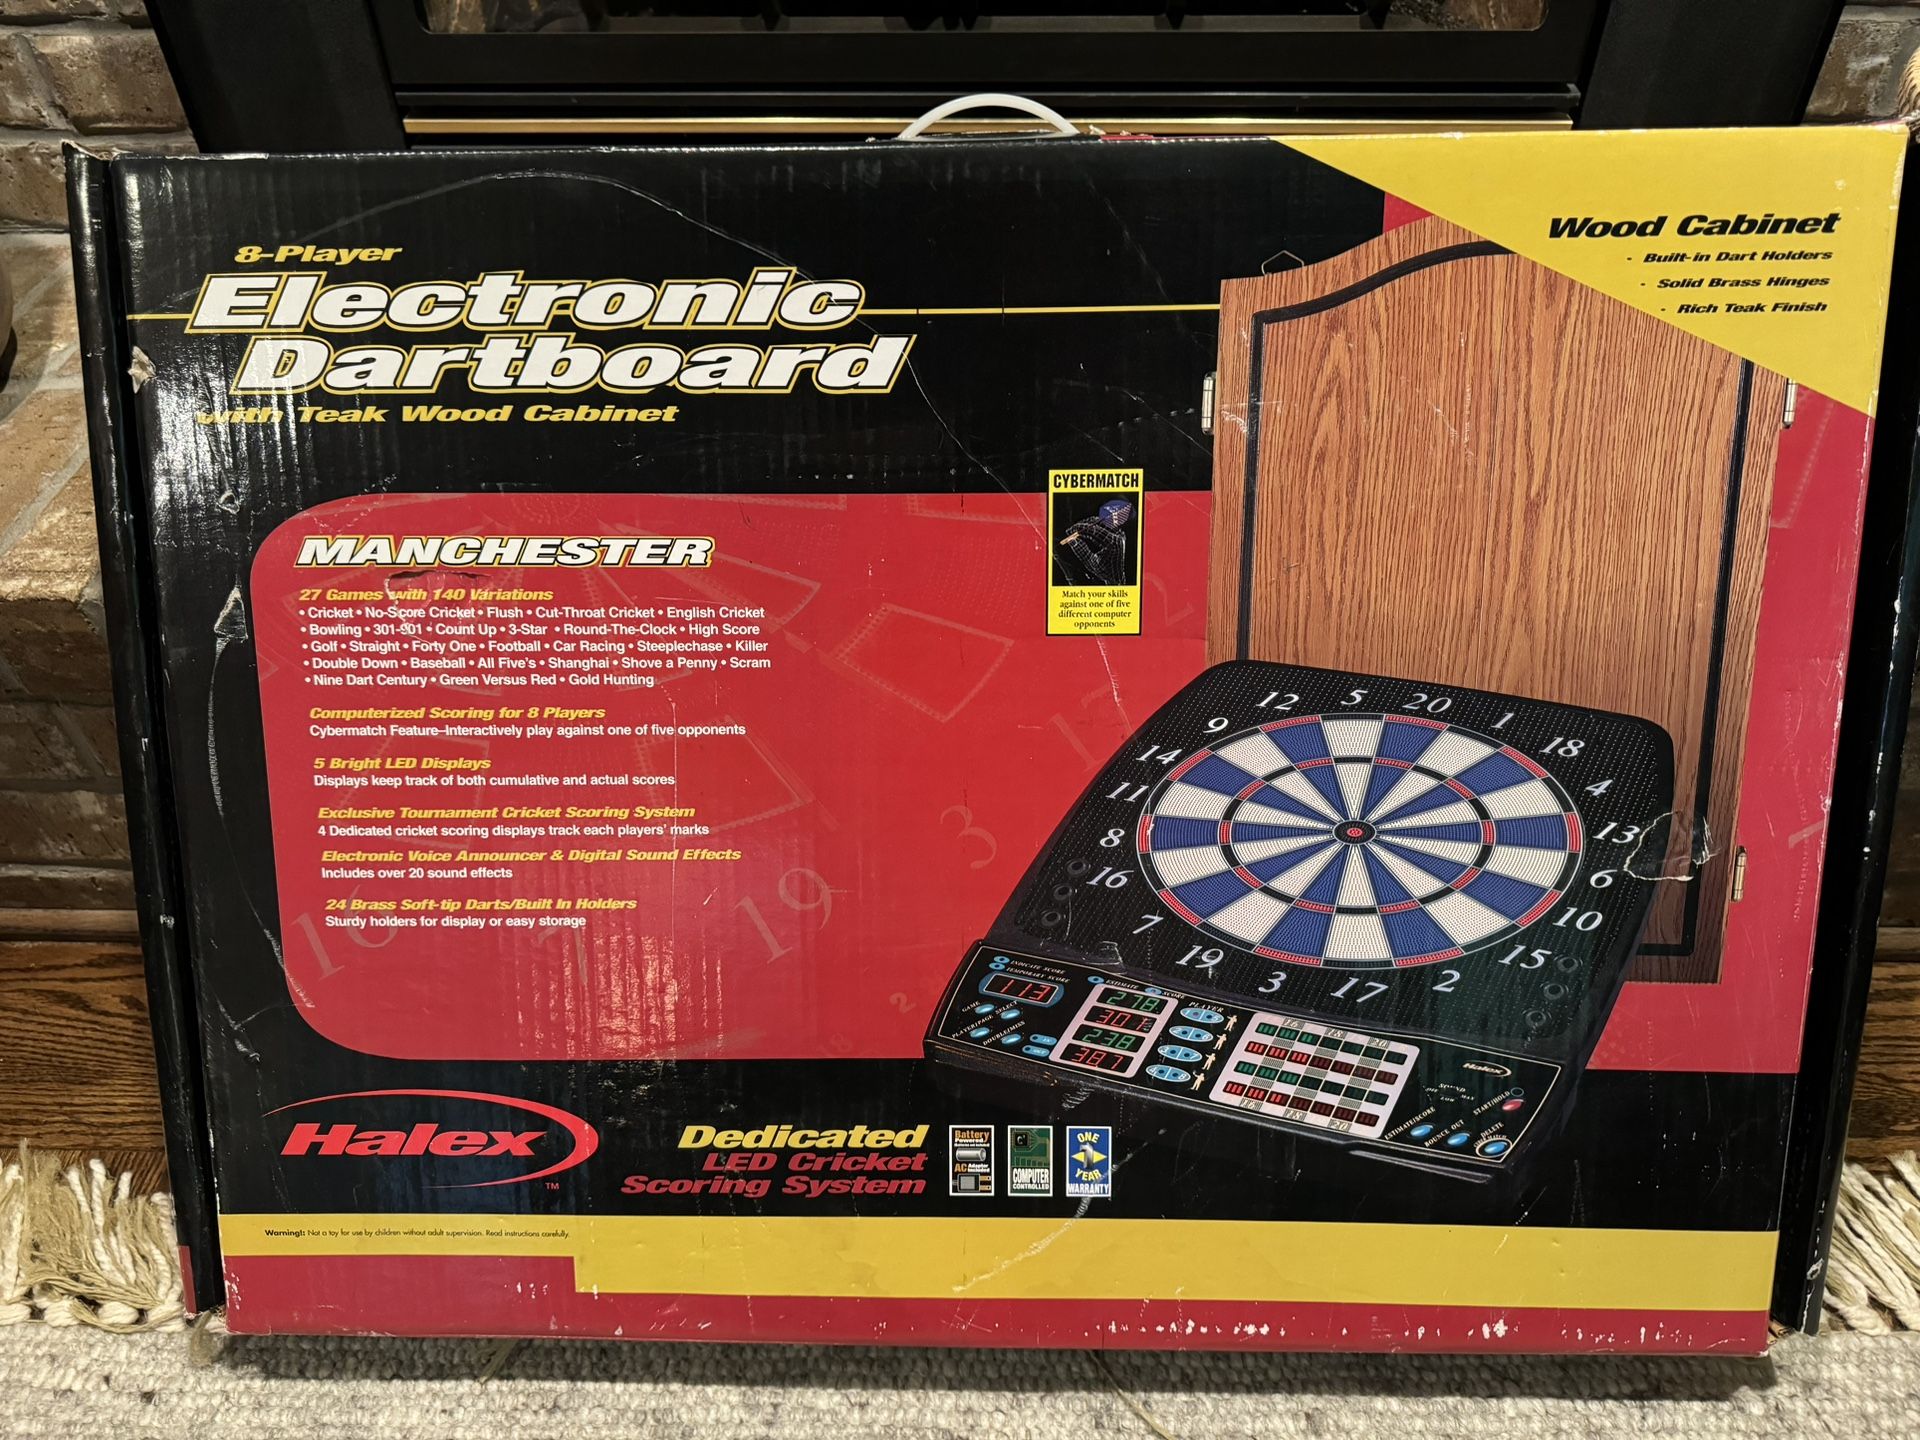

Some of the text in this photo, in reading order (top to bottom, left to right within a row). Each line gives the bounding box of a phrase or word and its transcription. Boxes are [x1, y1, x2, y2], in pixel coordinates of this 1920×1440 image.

[1548, 212, 1841, 238] Wood Cabinet
[234, 245, 403, 264] 8-Player
[1643, 250, 1833, 263] Built-in Dart Holders
[1656, 276, 1830, 289] Solid Brass Hinges
[184, 267, 866, 332] Electronic
[1676, 301, 1828, 314] Rich Teak Finish
[229, 333, 917, 394] Dartboard
[196, 404, 679, 424] with Teak Wood Cabinet
[1053, 472, 1139, 488] CYBERMATCH
[294, 535, 716, 567] MANCHESTER
[299, 588, 554, 601] 27 Games with 140 Variations
[1061, 589, 1128, 600] Match your skills
[307, 606, 765, 621] Cricket No-Score Cricket Flush Cut-Throat Cricket English Cricket
[1059, 599, 1087, 610] against
[1105, 599, 1115, 608] of
[1116, 599, 1131, 608] five
[1058, 609, 1132, 620] different computer
[309, 623, 362, 638] Bowling
[435, 622, 476, 635] Count
[477, 623, 497, 638] Up
[508, 623, 548, 635] 3-Star
[563, 623, 677, 635] Round-The-Clock
[688, 623, 718, 638] High
[722, 623, 760, 635] Score
[1073, 620, 1115, 630] opponents
[1259, 689, 1301, 711] 12
[1342, 689, 1368, 708] 5
[1401, 692, 1451, 714] 20
[309, 706, 606, 721] Computerized Scoring for 8 Players
[1494, 711, 1514, 730] 1
[309, 724, 387, 739] Cybermatch
[526, 724, 553, 739] play
[556, 724, 604, 739] against
[607, 726, 632, 735] one
[634, 723, 648, 736] of
[650, 722, 676, 736] five
[677, 723, 746, 738] opponents
[1203, 717, 1229, 735] 9
[1137, 745, 1182, 765] 14
[1539, 736, 1585, 758] 18
[1106, 781, 1151, 802] 11
[1585, 778, 1614, 796] 4
[1099, 828, 1126, 848] 8
[1594, 822, 1641, 843] 13
[321, 848, 742, 863] Electronic Voice Announcer & Digital Sound Effects
[321, 866, 513, 879] Includes over 20 sound effects
[1086, 866, 1135, 890] 16
[1590, 868, 1613, 889] 6
[324, 897, 637, 912] 24 Brass Soft-tip Darts/Built In Holders
[325, 915, 586, 930] Sturdy holders for display or easy storage
[1132, 914, 1162, 935] 7
[1553, 907, 1603, 931] 10
[1176, 945, 1225, 969] 19
[1498, 944, 1552, 970] 15
[1001, 979, 1052, 1001] 113
[1259, 972, 1288, 993] 3
[1331, 977, 1387, 1002] 17
[1432, 970, 1461, 992] 2
[1106, 991, 1160, 1012] 278
[1189, 1001, 1224, 1013] PLAYER
[1082, 1028, 1135, 1050] 238
[1072, 1047, 1124, 1070] 387
[280, 1122, 547, 1156] Halex
[677, 1124, 930, 1148] Dedicated
[954, 1130, 990, 1143] Battery
[1077, 1132, 1100, 1143] ONE
[1424, 1119, 1465, 1147] BOUNCE OUT
[702, 1152, 928, 1171] LED Cricket
[954, 1163, 968, 1173] AC
[1012, 1168, 1050, 1184] COMPUTER
[1075, 1168, 1102, 1182] YEAR
[545, 1182, 560, 1191] TM
[620, 1175, 926, 1197] Scoring System
[1068, 1183, 1109, 1194] WARRANTY
